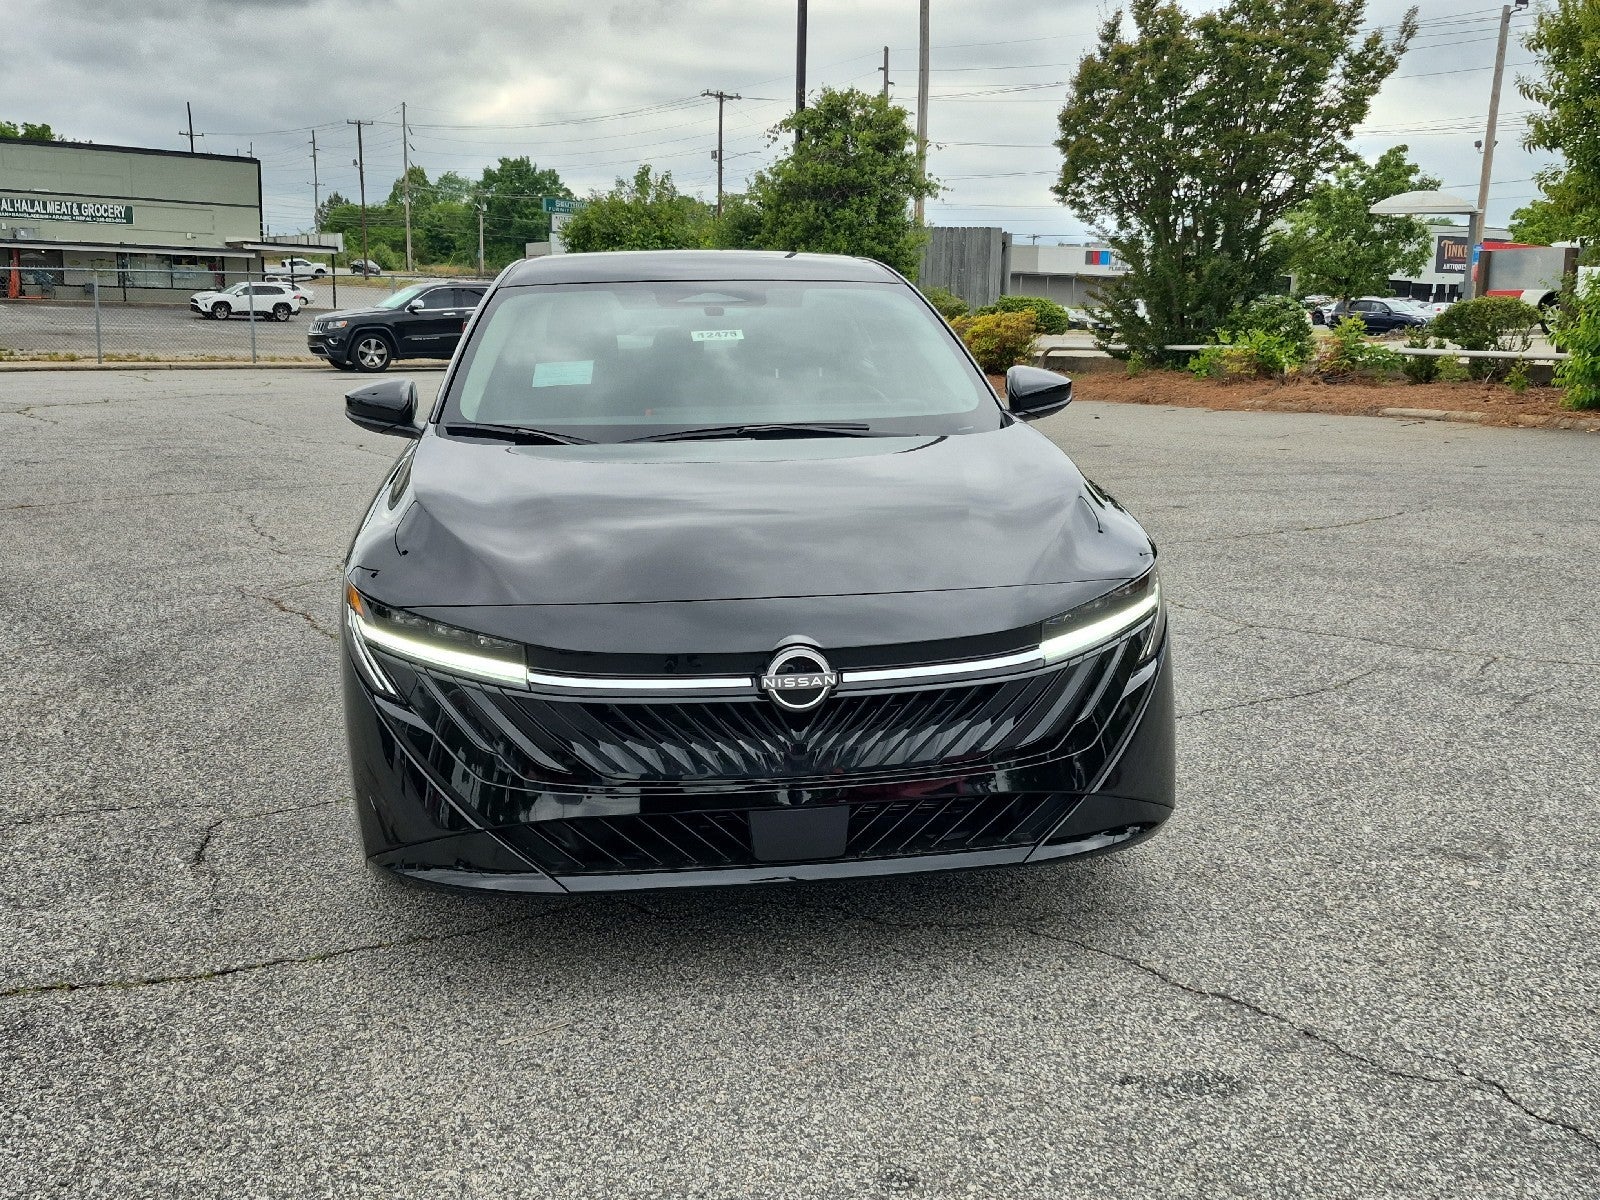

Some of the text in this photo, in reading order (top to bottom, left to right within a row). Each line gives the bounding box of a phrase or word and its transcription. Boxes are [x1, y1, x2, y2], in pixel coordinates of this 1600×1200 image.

[14, 199, 46, 214] HALAL
[47, 201, 71, 215] MEAT
[72, 203, 80, 216] &
[81, 203, 126, 218] GROCERY
[1441, 239, 1468, 260] TINKE
[763, 674, 836, 688] NISSAN
